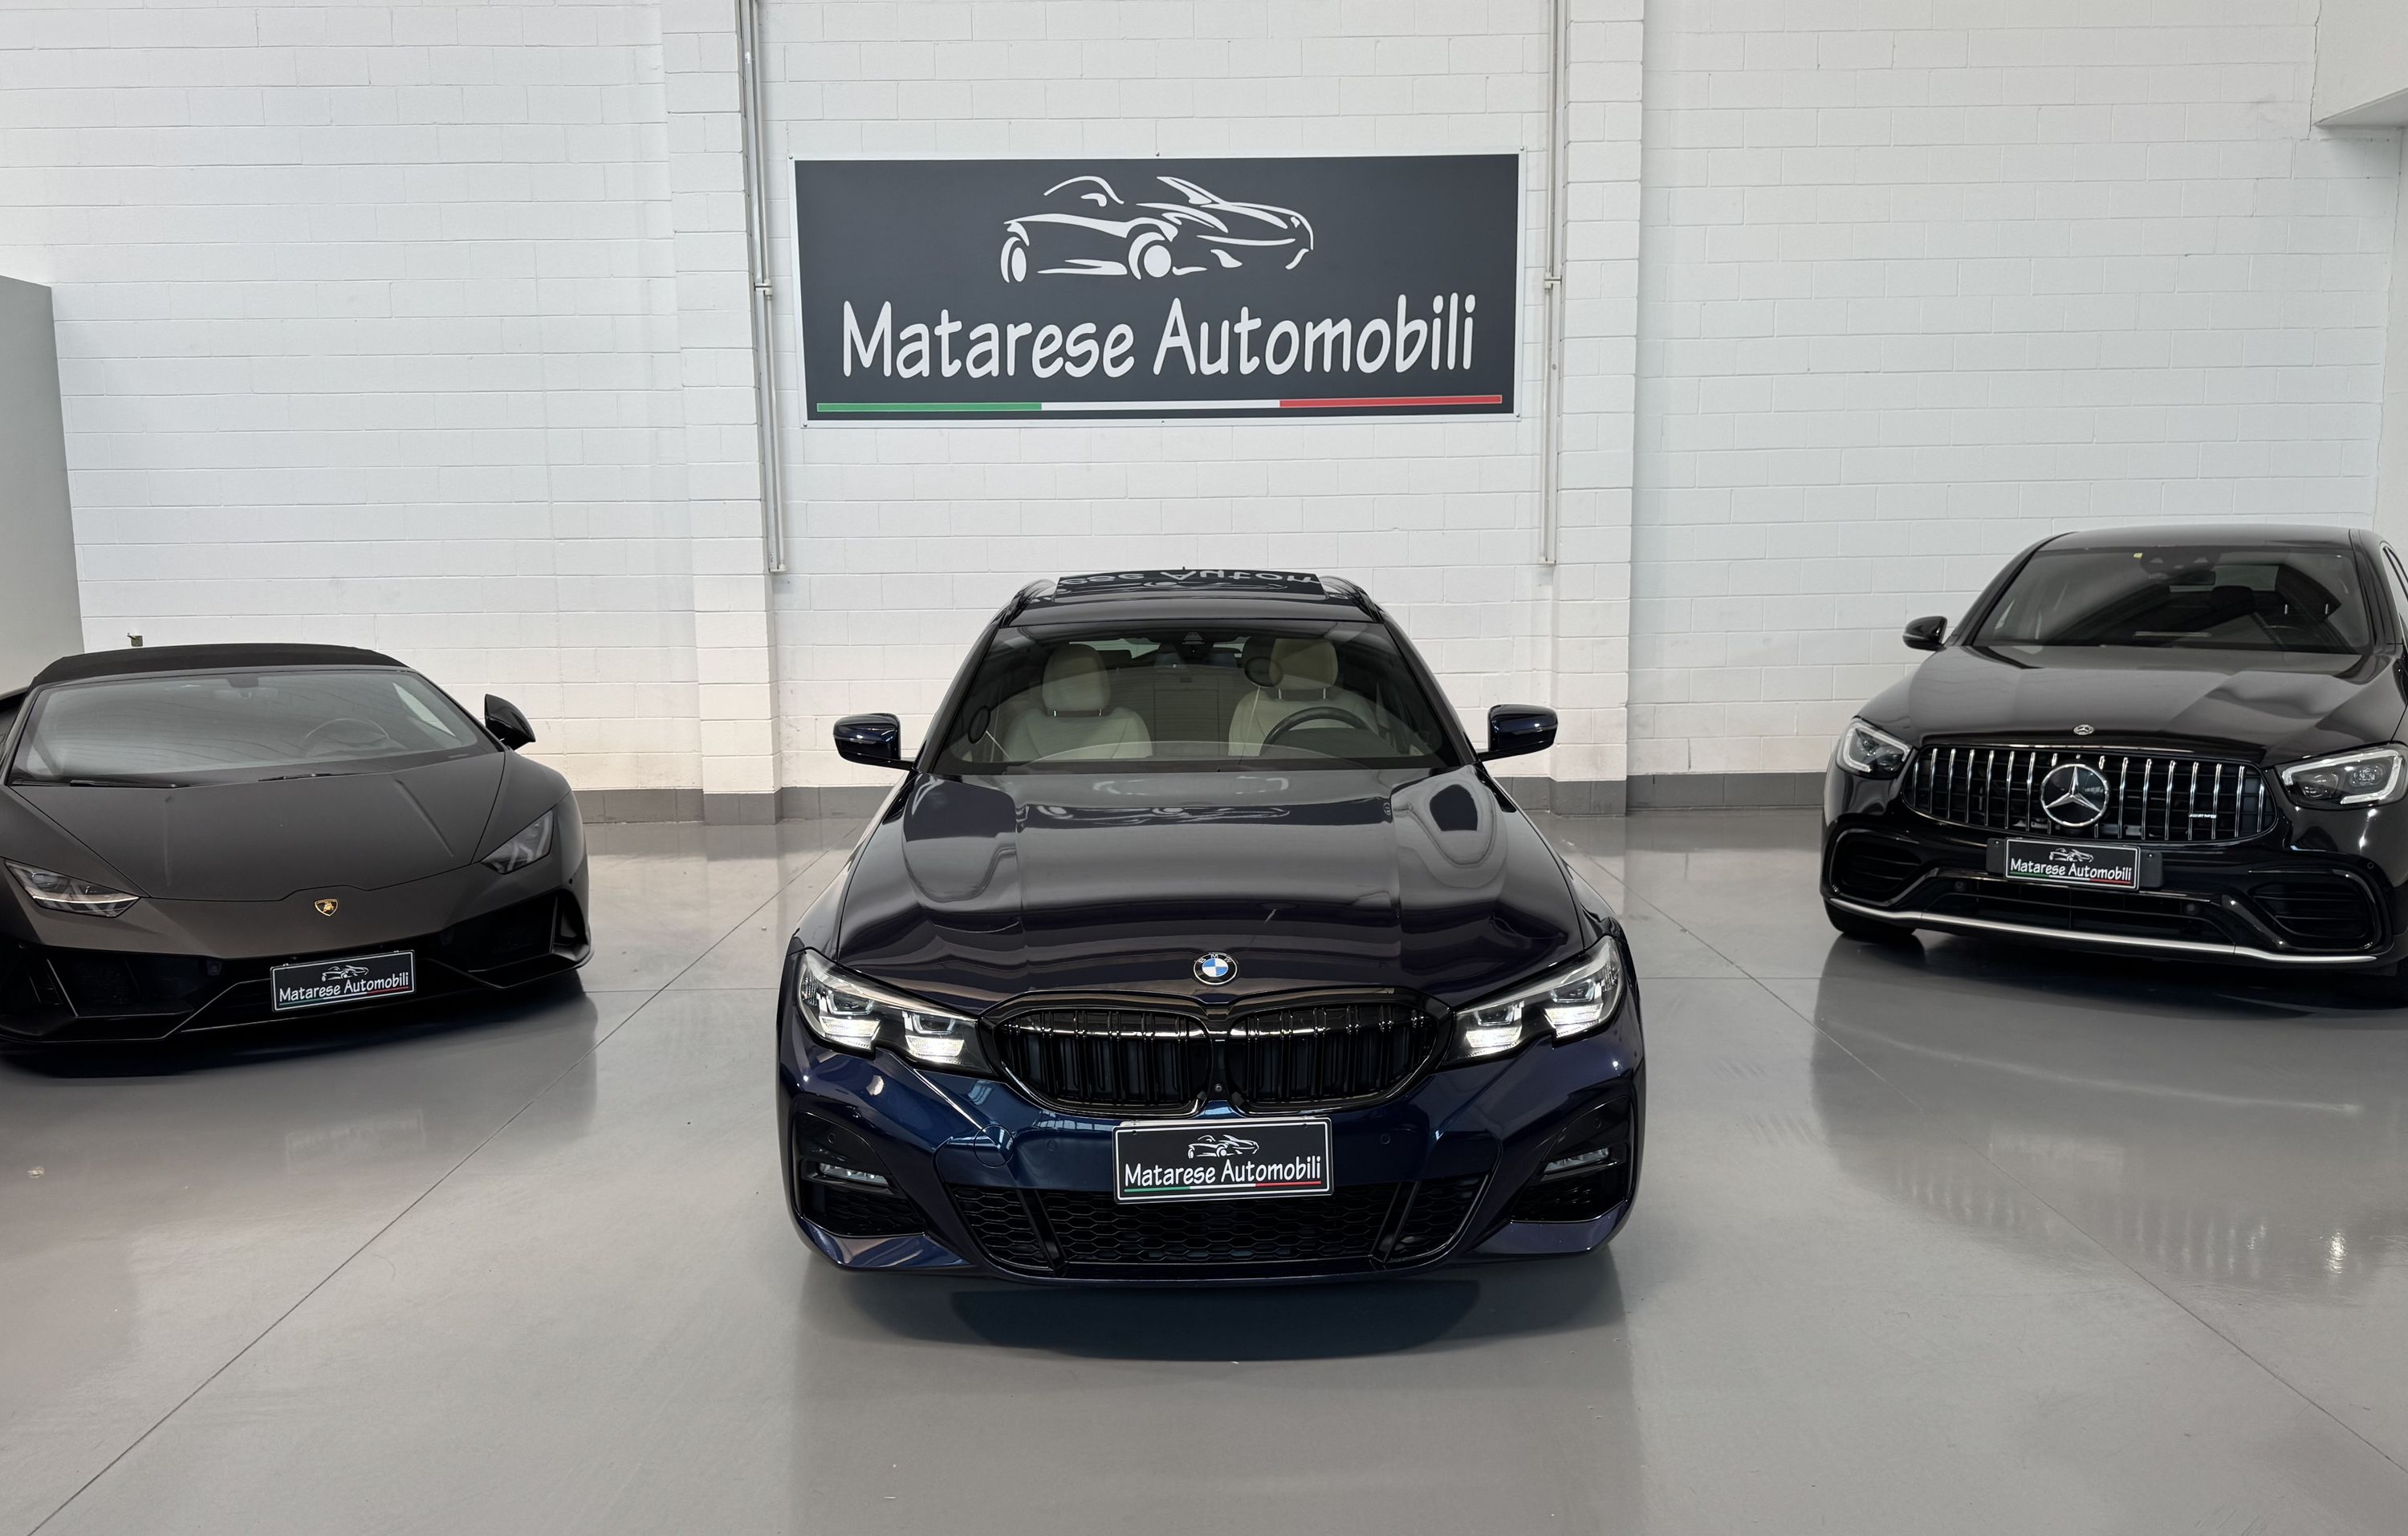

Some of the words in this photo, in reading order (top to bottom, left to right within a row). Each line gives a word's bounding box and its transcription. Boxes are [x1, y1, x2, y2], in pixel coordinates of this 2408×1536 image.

[843, 300, 1135, 379] Matarese
[1153, 292, 1476, 376] Automobili
[2010, 858, 2065, 876] Matarese
[2068, 863, 2132, 881] Automobili
[1198, 953, 1232, 964] BMW
[279, 985, 341, 1002] Matarese
[344, 972, 409, 994] Automobili
[1125, 1163, 1216, 1187] Matarese
[1220, 1155, 1321, 1183] Automobili
